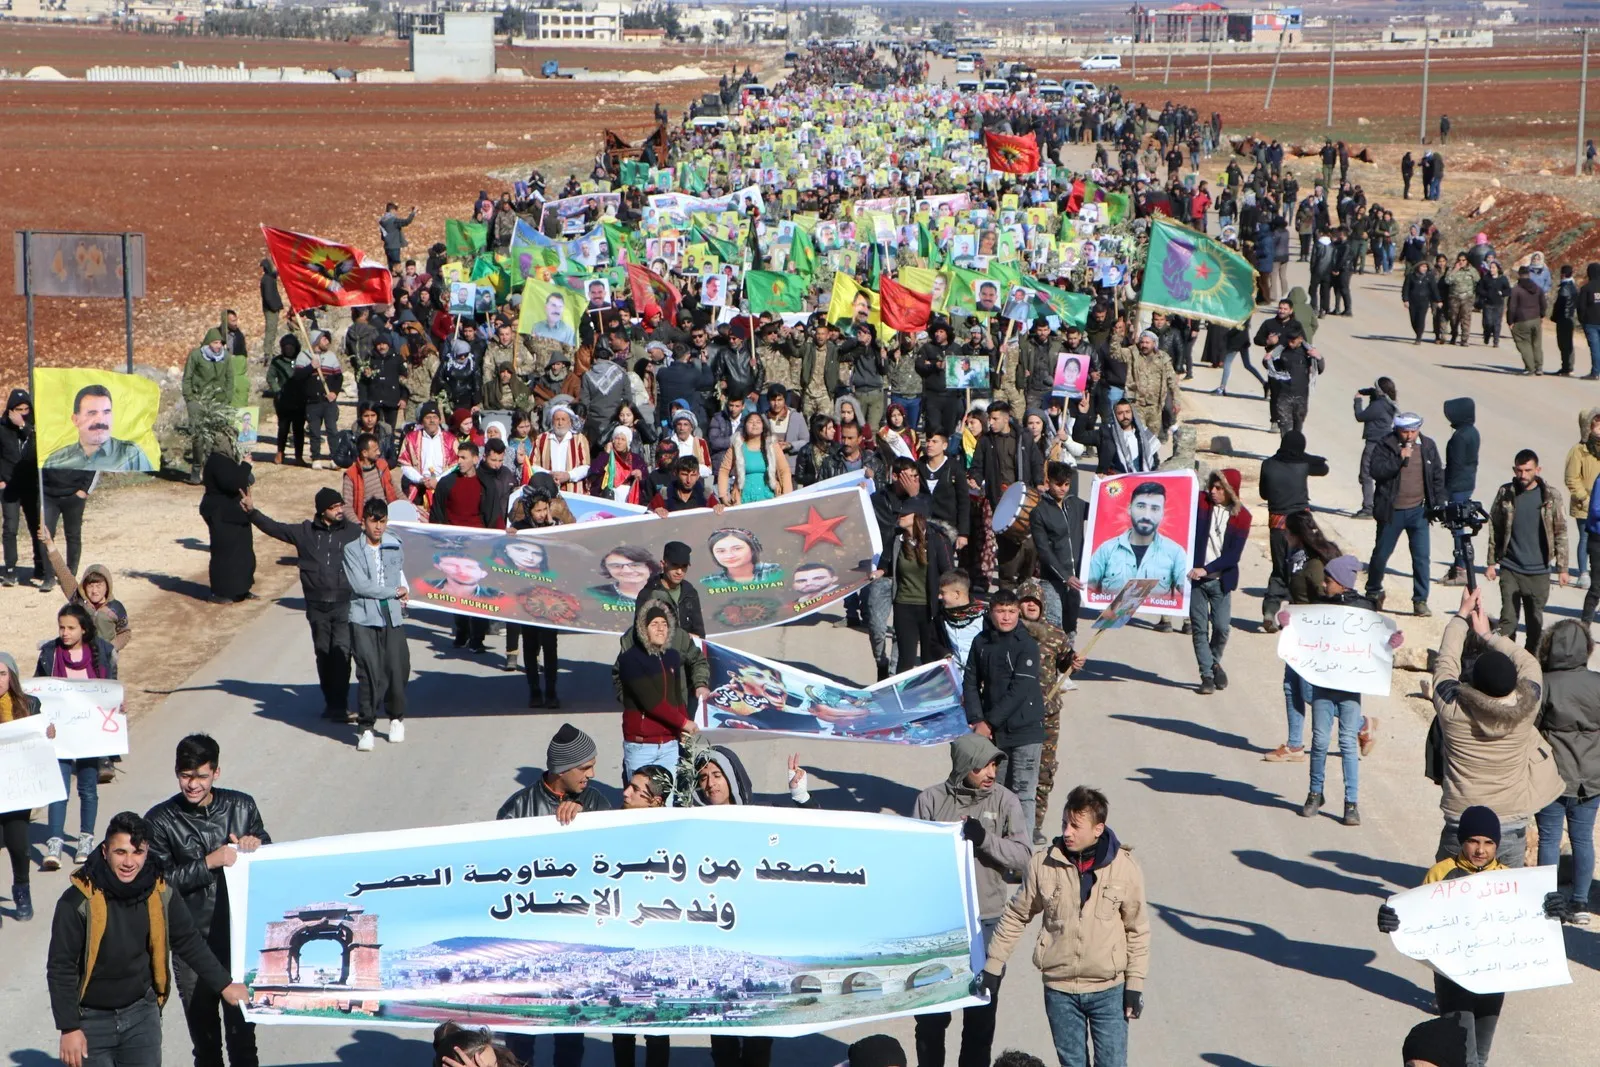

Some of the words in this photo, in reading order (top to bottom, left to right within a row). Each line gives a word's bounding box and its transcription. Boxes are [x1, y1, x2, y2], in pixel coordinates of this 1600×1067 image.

[460, 598, 500, 612] MURHEF
[1301, 612, 1336, 626] مقاومة
[96, 706, 119, 733] لا
[463, 857, 578, 885] مقاومة
[593, 849, 687, 882] وتيرة
[699, 857, 741, 884] من
[347, 866, 451, 897] العصر
[1430, 880, 1472, 900] APO
[1477, 881, 1518, 899] القائد
[490, 887, 620, 927] الإحتلال
[630, 894, 736, 931] وندحر
